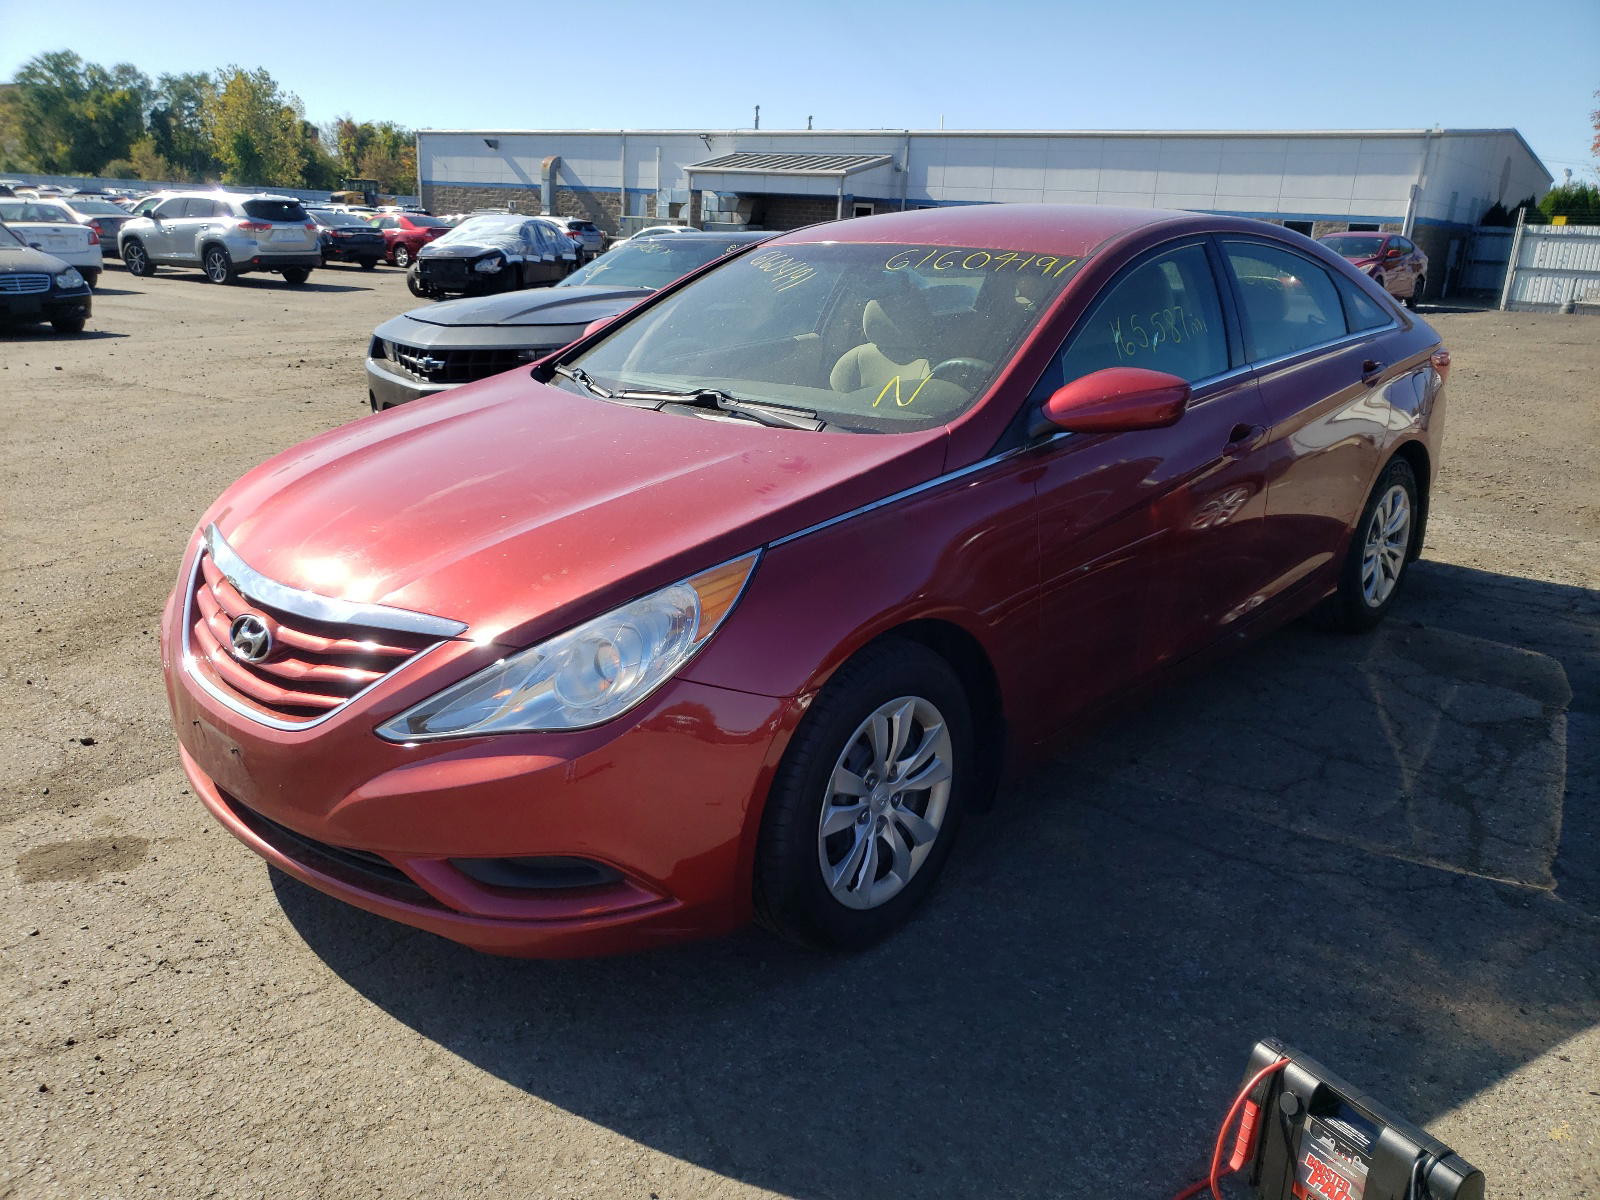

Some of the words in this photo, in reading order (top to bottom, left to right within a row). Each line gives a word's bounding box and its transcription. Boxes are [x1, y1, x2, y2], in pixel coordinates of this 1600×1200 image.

[885, 249, 1076, 278] 61604191
[873, 372, 935, 408] N
[1304, 1152, 1352, 1195] BOOSTER
